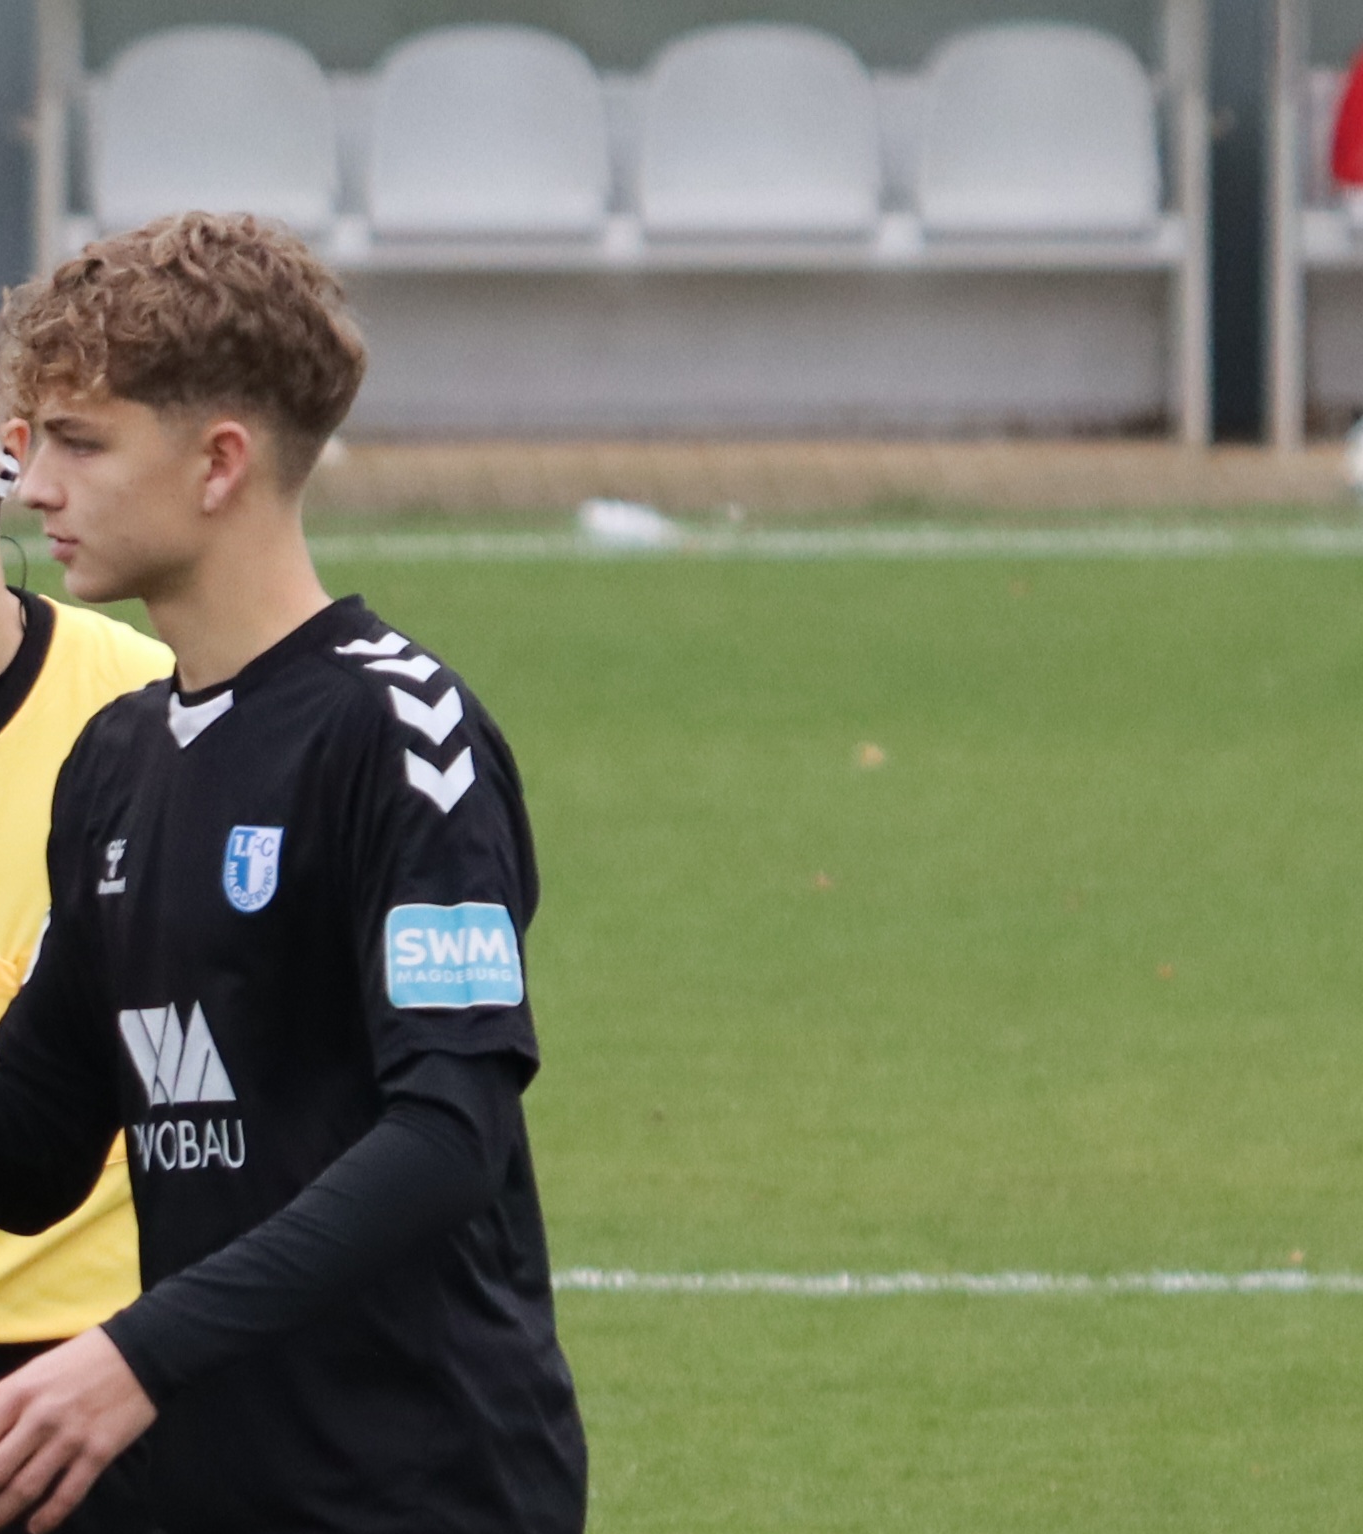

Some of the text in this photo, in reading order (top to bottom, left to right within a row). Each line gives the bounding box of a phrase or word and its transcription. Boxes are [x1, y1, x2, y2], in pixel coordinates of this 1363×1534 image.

[395, 926, 512, 966] SWM
[395, 967, 514, 984] MAGDEBURG
[132, 1118, 246, 1173] WOBAU
